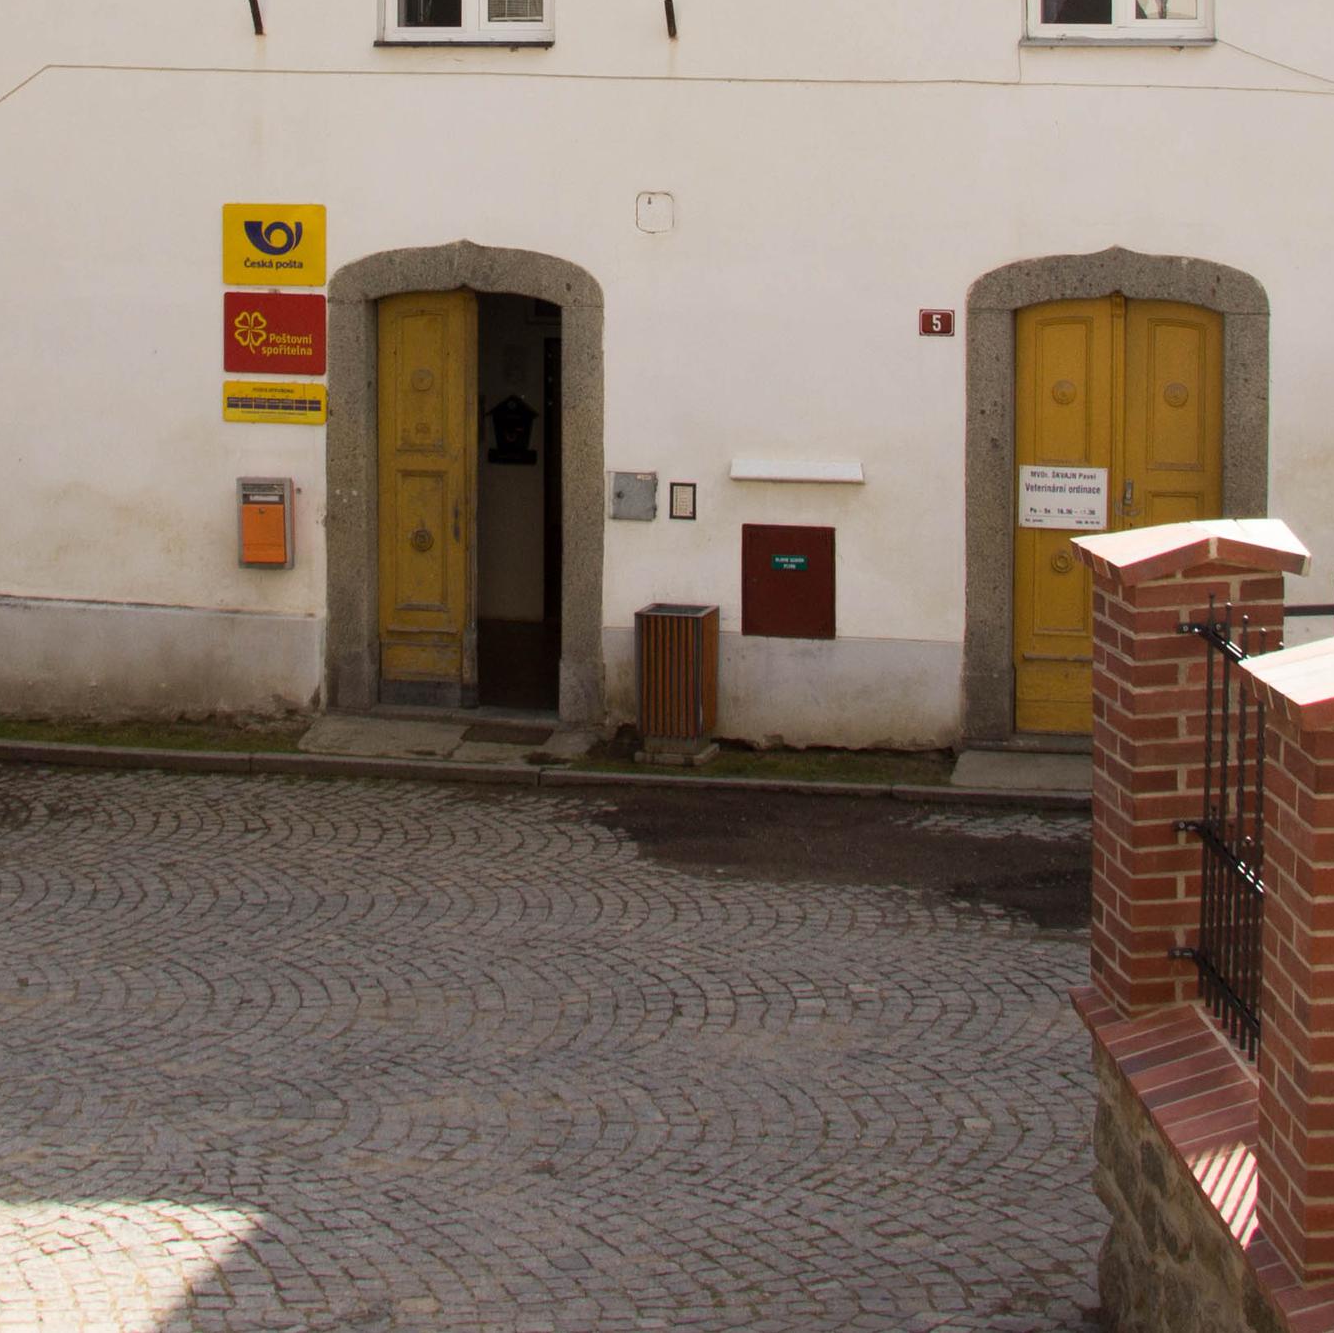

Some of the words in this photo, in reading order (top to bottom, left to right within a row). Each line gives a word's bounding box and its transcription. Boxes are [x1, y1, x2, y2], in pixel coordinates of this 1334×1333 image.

[244, 257, 273, 268] Česká
[276, 259, 303, 270] pošta
[932, 314, 942, 332] 5
[269, 333, 312, 344] Poštovní
[261, 345, 313, 357] spořitelna
[1025, 483, 1066, 493] Veterinární
[1068, 484, 1101, 495] ordinace
